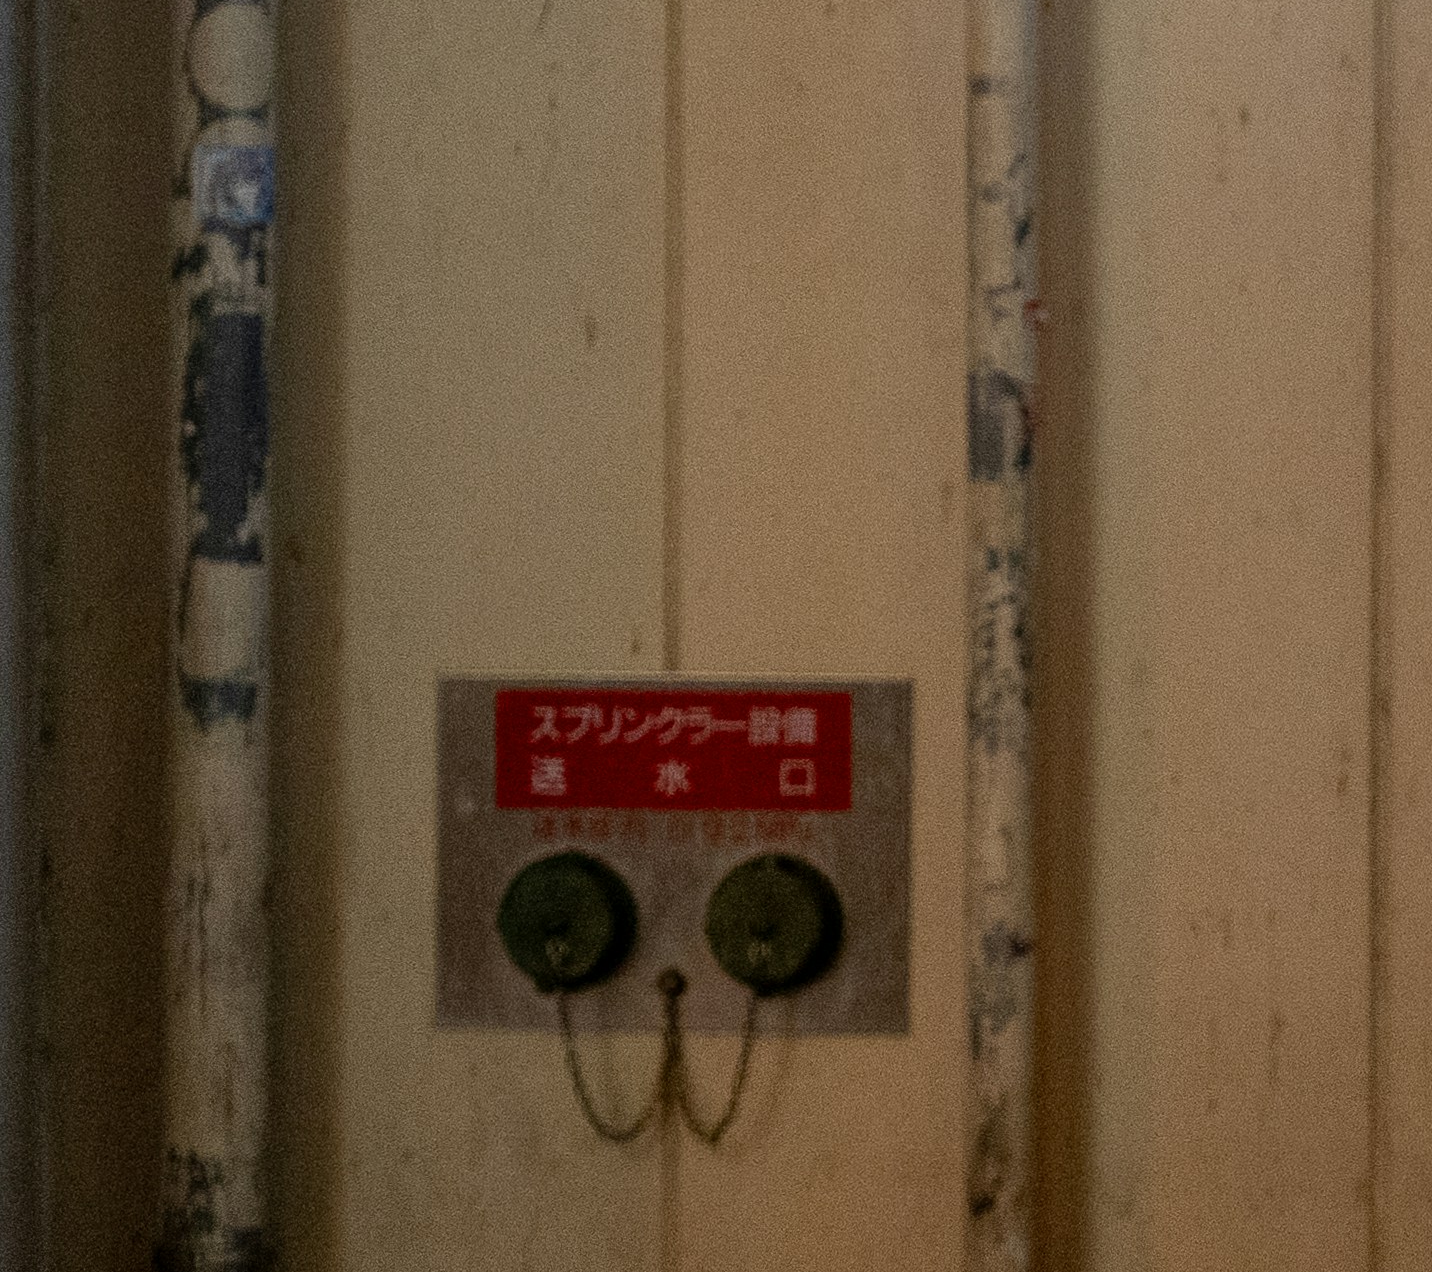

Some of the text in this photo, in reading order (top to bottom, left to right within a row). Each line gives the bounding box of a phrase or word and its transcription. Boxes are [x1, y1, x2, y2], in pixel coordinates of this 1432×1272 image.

[529, 703, 820, 747] スプリンクラー設備
[529, 755, 818, 798] 送水口
